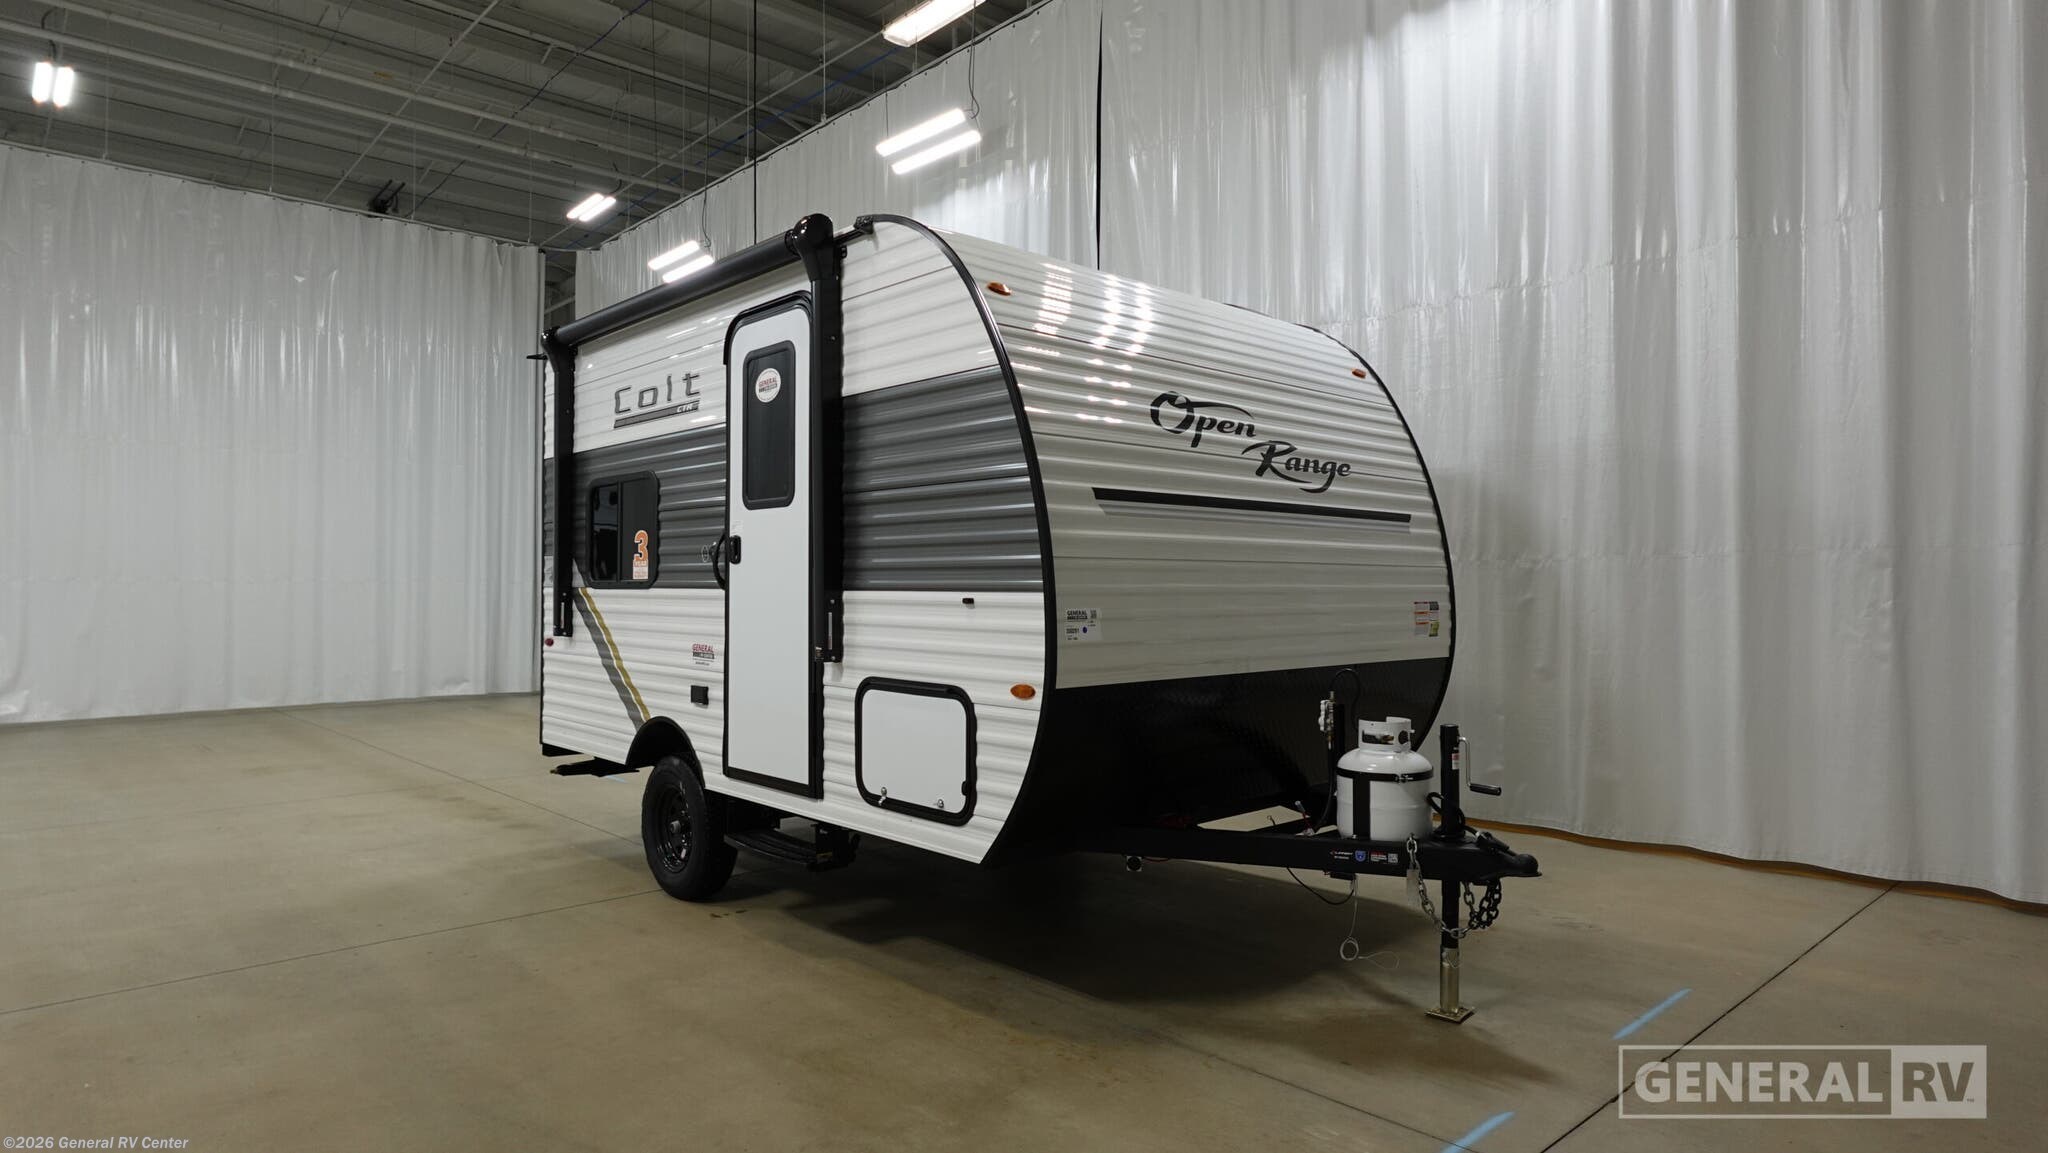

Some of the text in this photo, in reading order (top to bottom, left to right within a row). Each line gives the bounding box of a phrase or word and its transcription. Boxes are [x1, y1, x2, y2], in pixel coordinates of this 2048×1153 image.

[614, 372, 700, 414] Colt
[1150, 390, 1257, 448] Open
[1241, 440, 1351, 494] Range
[633, 530, 648, 561] 3
[692, 643, 714, 653] GENERAL
